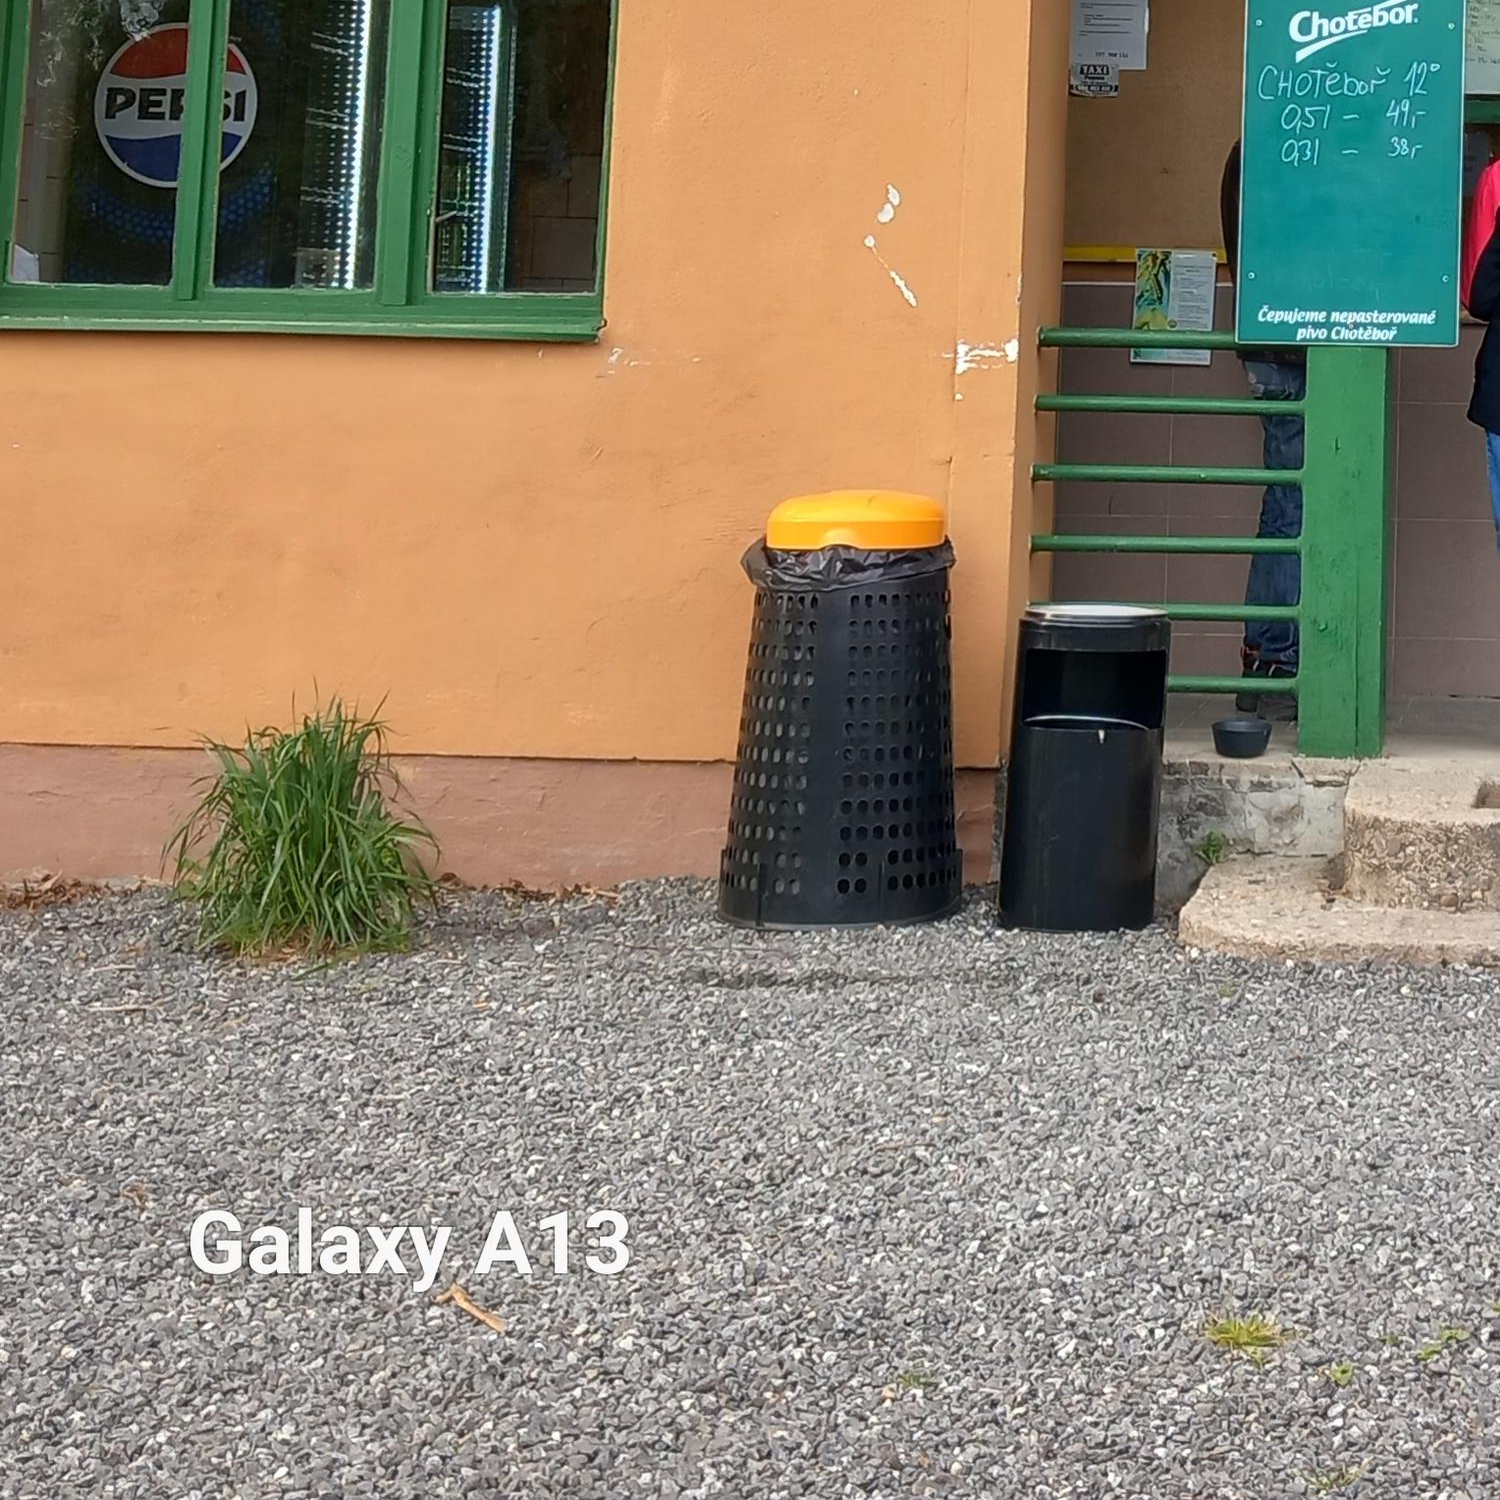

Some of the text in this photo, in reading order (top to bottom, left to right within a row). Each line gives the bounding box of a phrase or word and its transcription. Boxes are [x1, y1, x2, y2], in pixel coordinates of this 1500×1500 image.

[1083, 65, 1108, 75] TAXI
[1257, 304, 1437, 325] Čepujeme nepasterované
[1296, 325, 1398, 341] pivo Chotěboř
